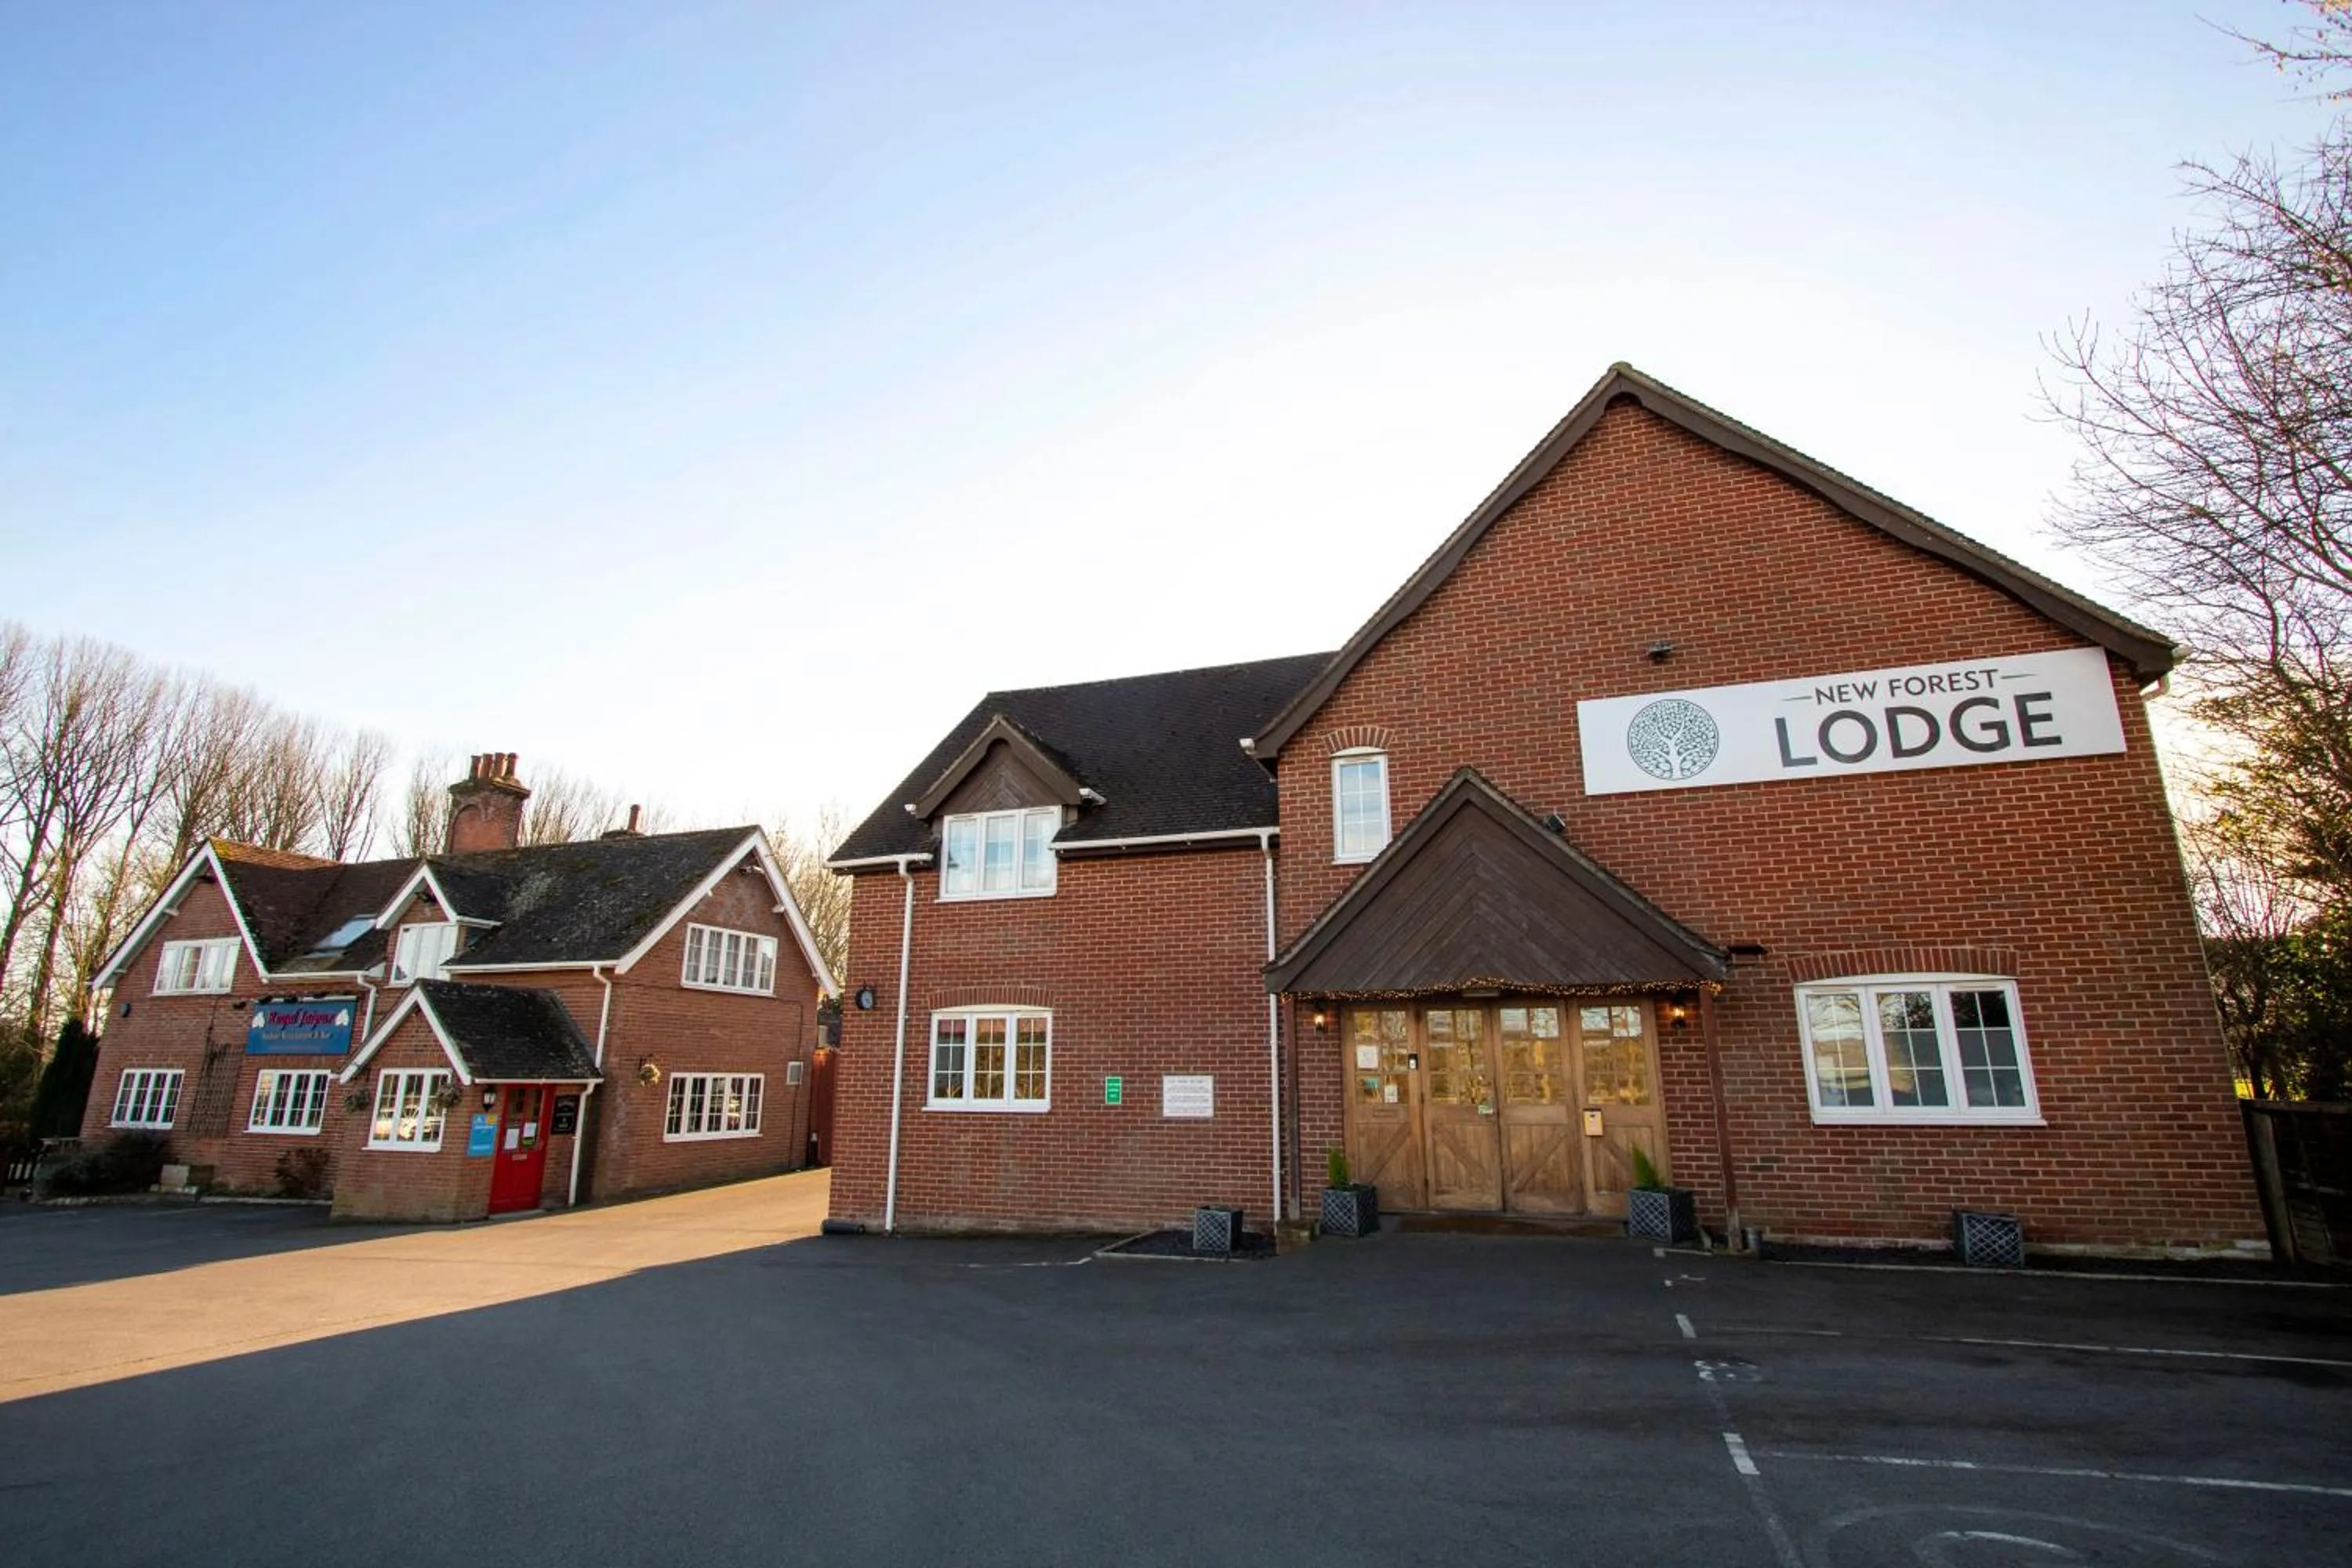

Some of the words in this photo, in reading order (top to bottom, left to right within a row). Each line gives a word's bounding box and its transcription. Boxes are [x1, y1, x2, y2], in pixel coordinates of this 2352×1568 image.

[1815, 681, 1877, 705] NEW
[1889, 669, 1998, 698] FOREST
[1774, 691, 2063, 768] LODGE
